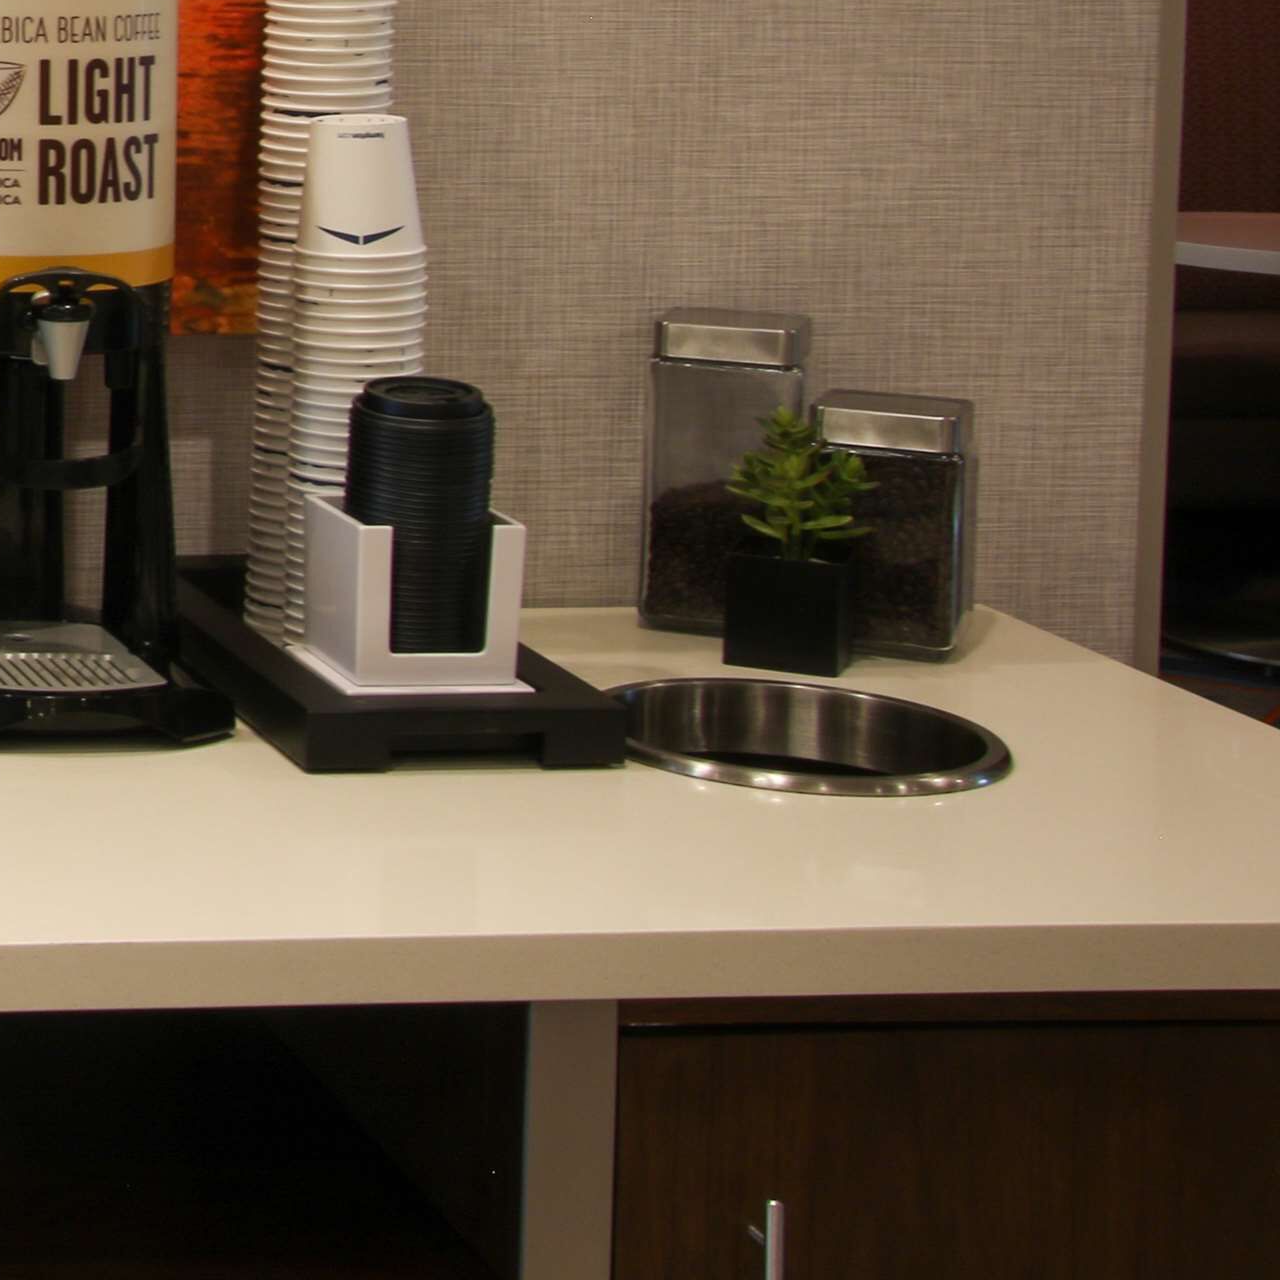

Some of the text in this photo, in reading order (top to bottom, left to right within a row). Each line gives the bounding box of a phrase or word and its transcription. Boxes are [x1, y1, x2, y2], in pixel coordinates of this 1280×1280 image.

[57, 15, 108, 45] BEAN
[113, 12, 162, 42] COFFEE
[37, 54, 156, 126] LIGHT
[36, 133, 160, 207] ROAST
